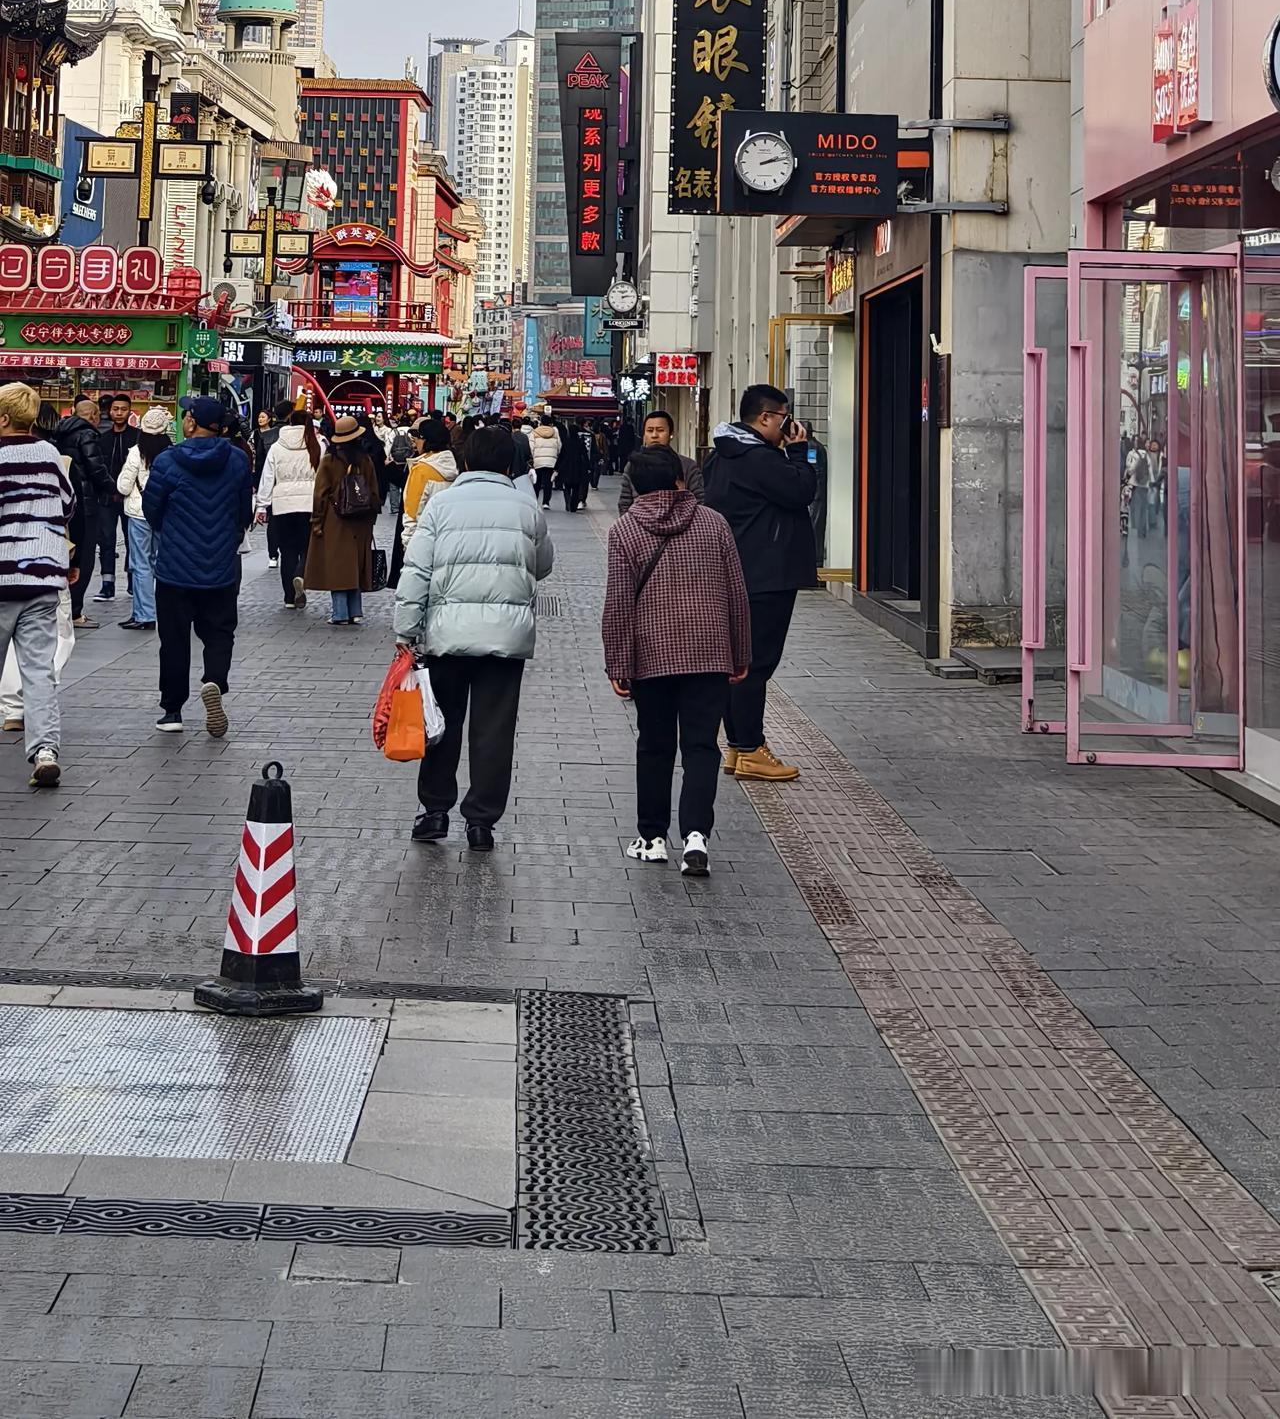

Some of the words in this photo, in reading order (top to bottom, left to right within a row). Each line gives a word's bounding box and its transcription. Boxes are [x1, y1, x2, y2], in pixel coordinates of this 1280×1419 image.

[567, 73, 610, 88] PEAK
[817, 133, 878, 151] MIDO
[674, 167, 719, 199] 名表
[72, 202, 97, 221] SKECHERS
[25, 326, 128, 340] 辽宁伴手礼专营店
